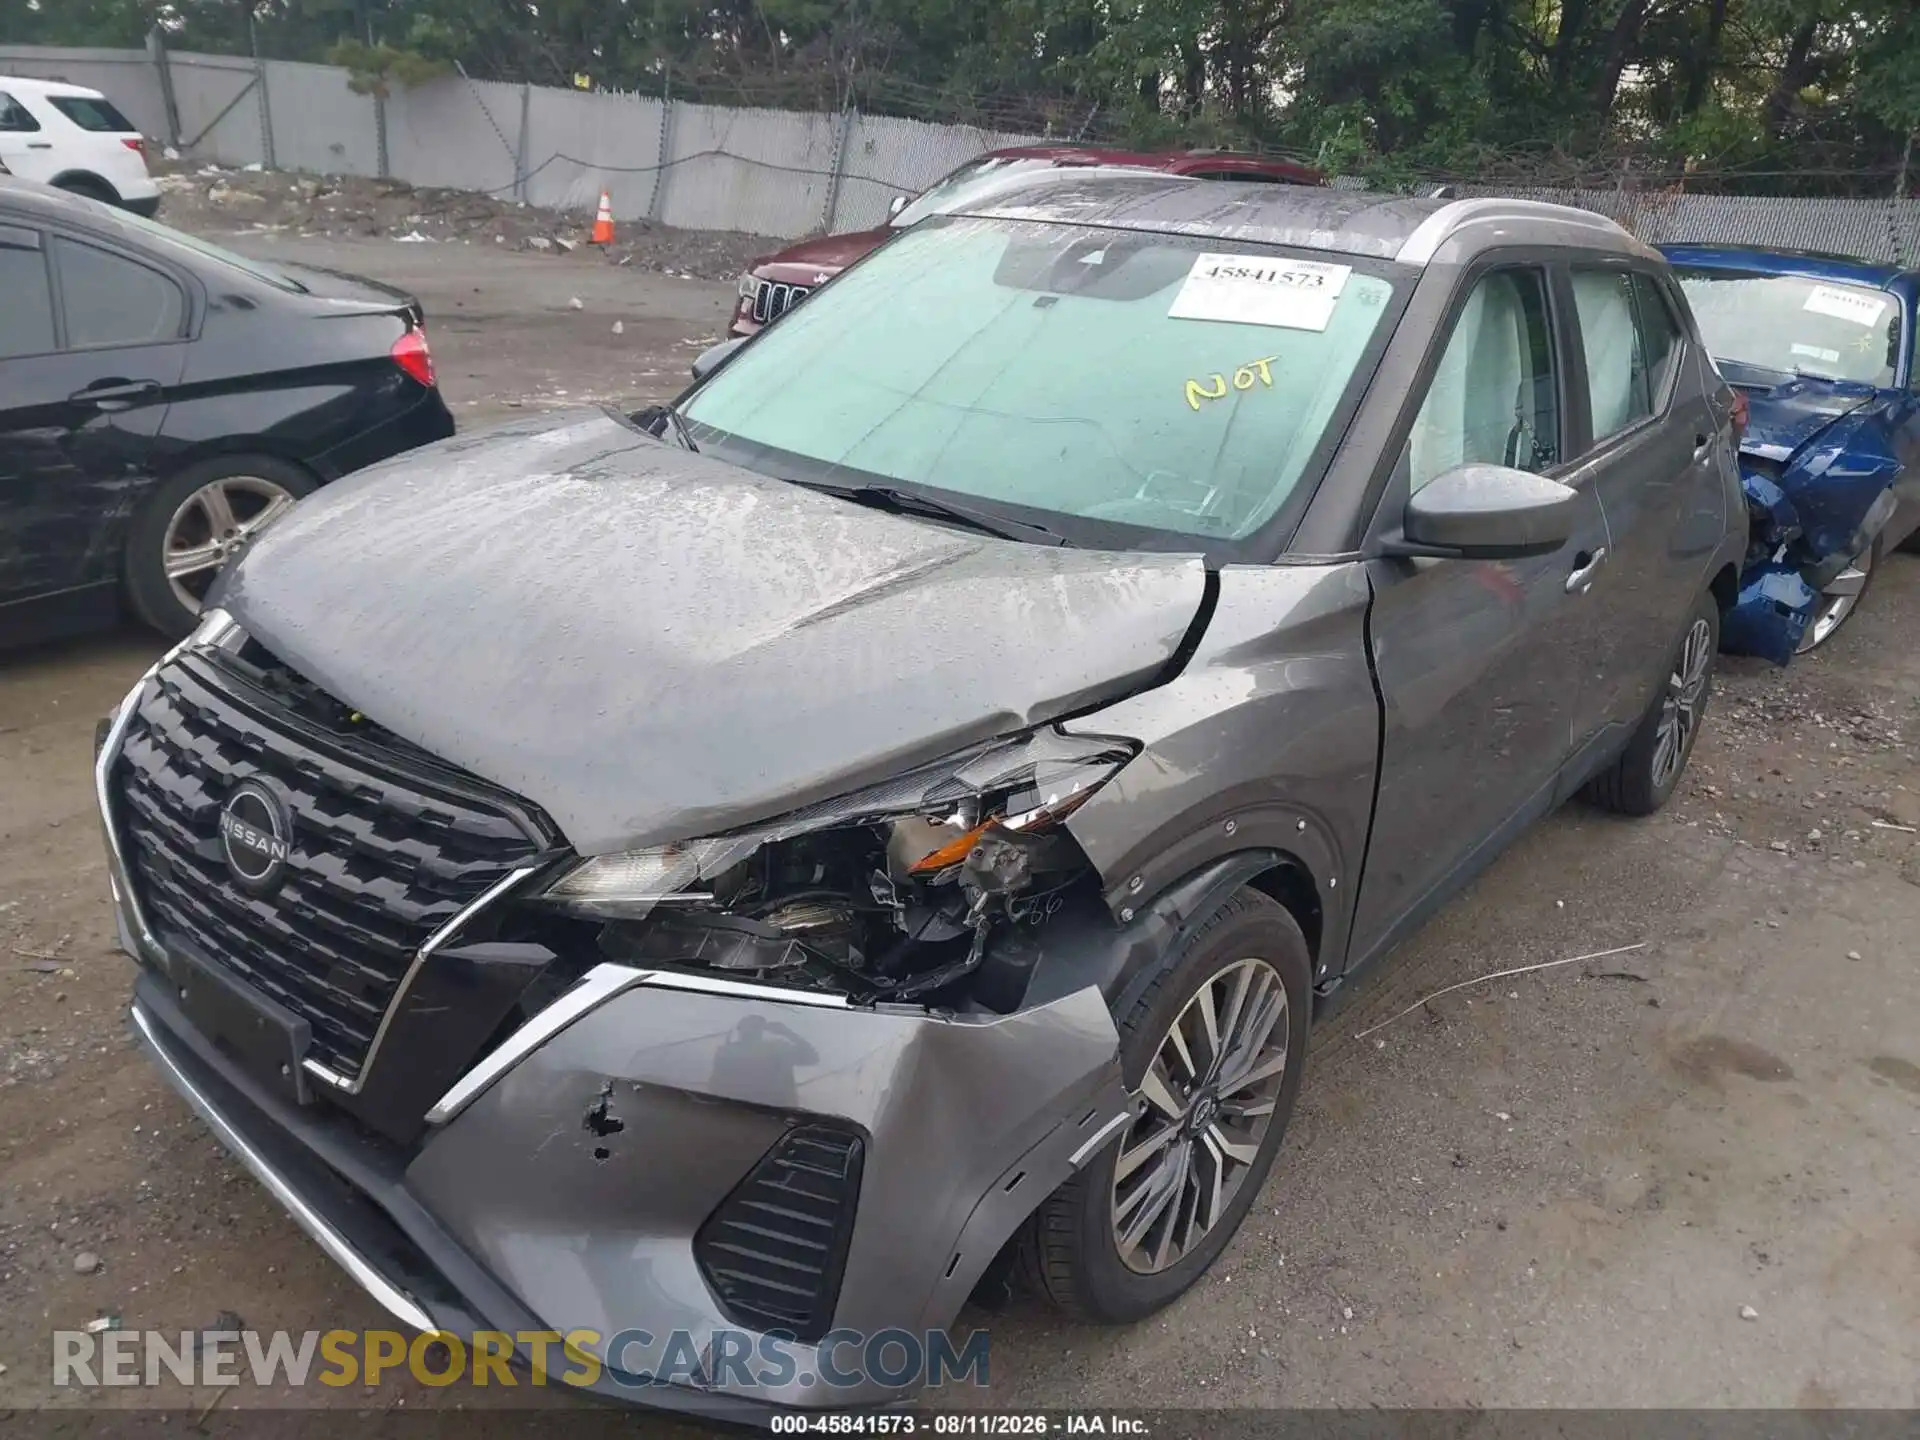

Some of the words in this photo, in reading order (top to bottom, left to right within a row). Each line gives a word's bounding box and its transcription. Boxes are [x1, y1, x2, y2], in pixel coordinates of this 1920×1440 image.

[1206, 266, 1324, 287] 45841573
[1185, 355, 1280, 411] NOT
[220, 812, 285, 859] NISSAN
